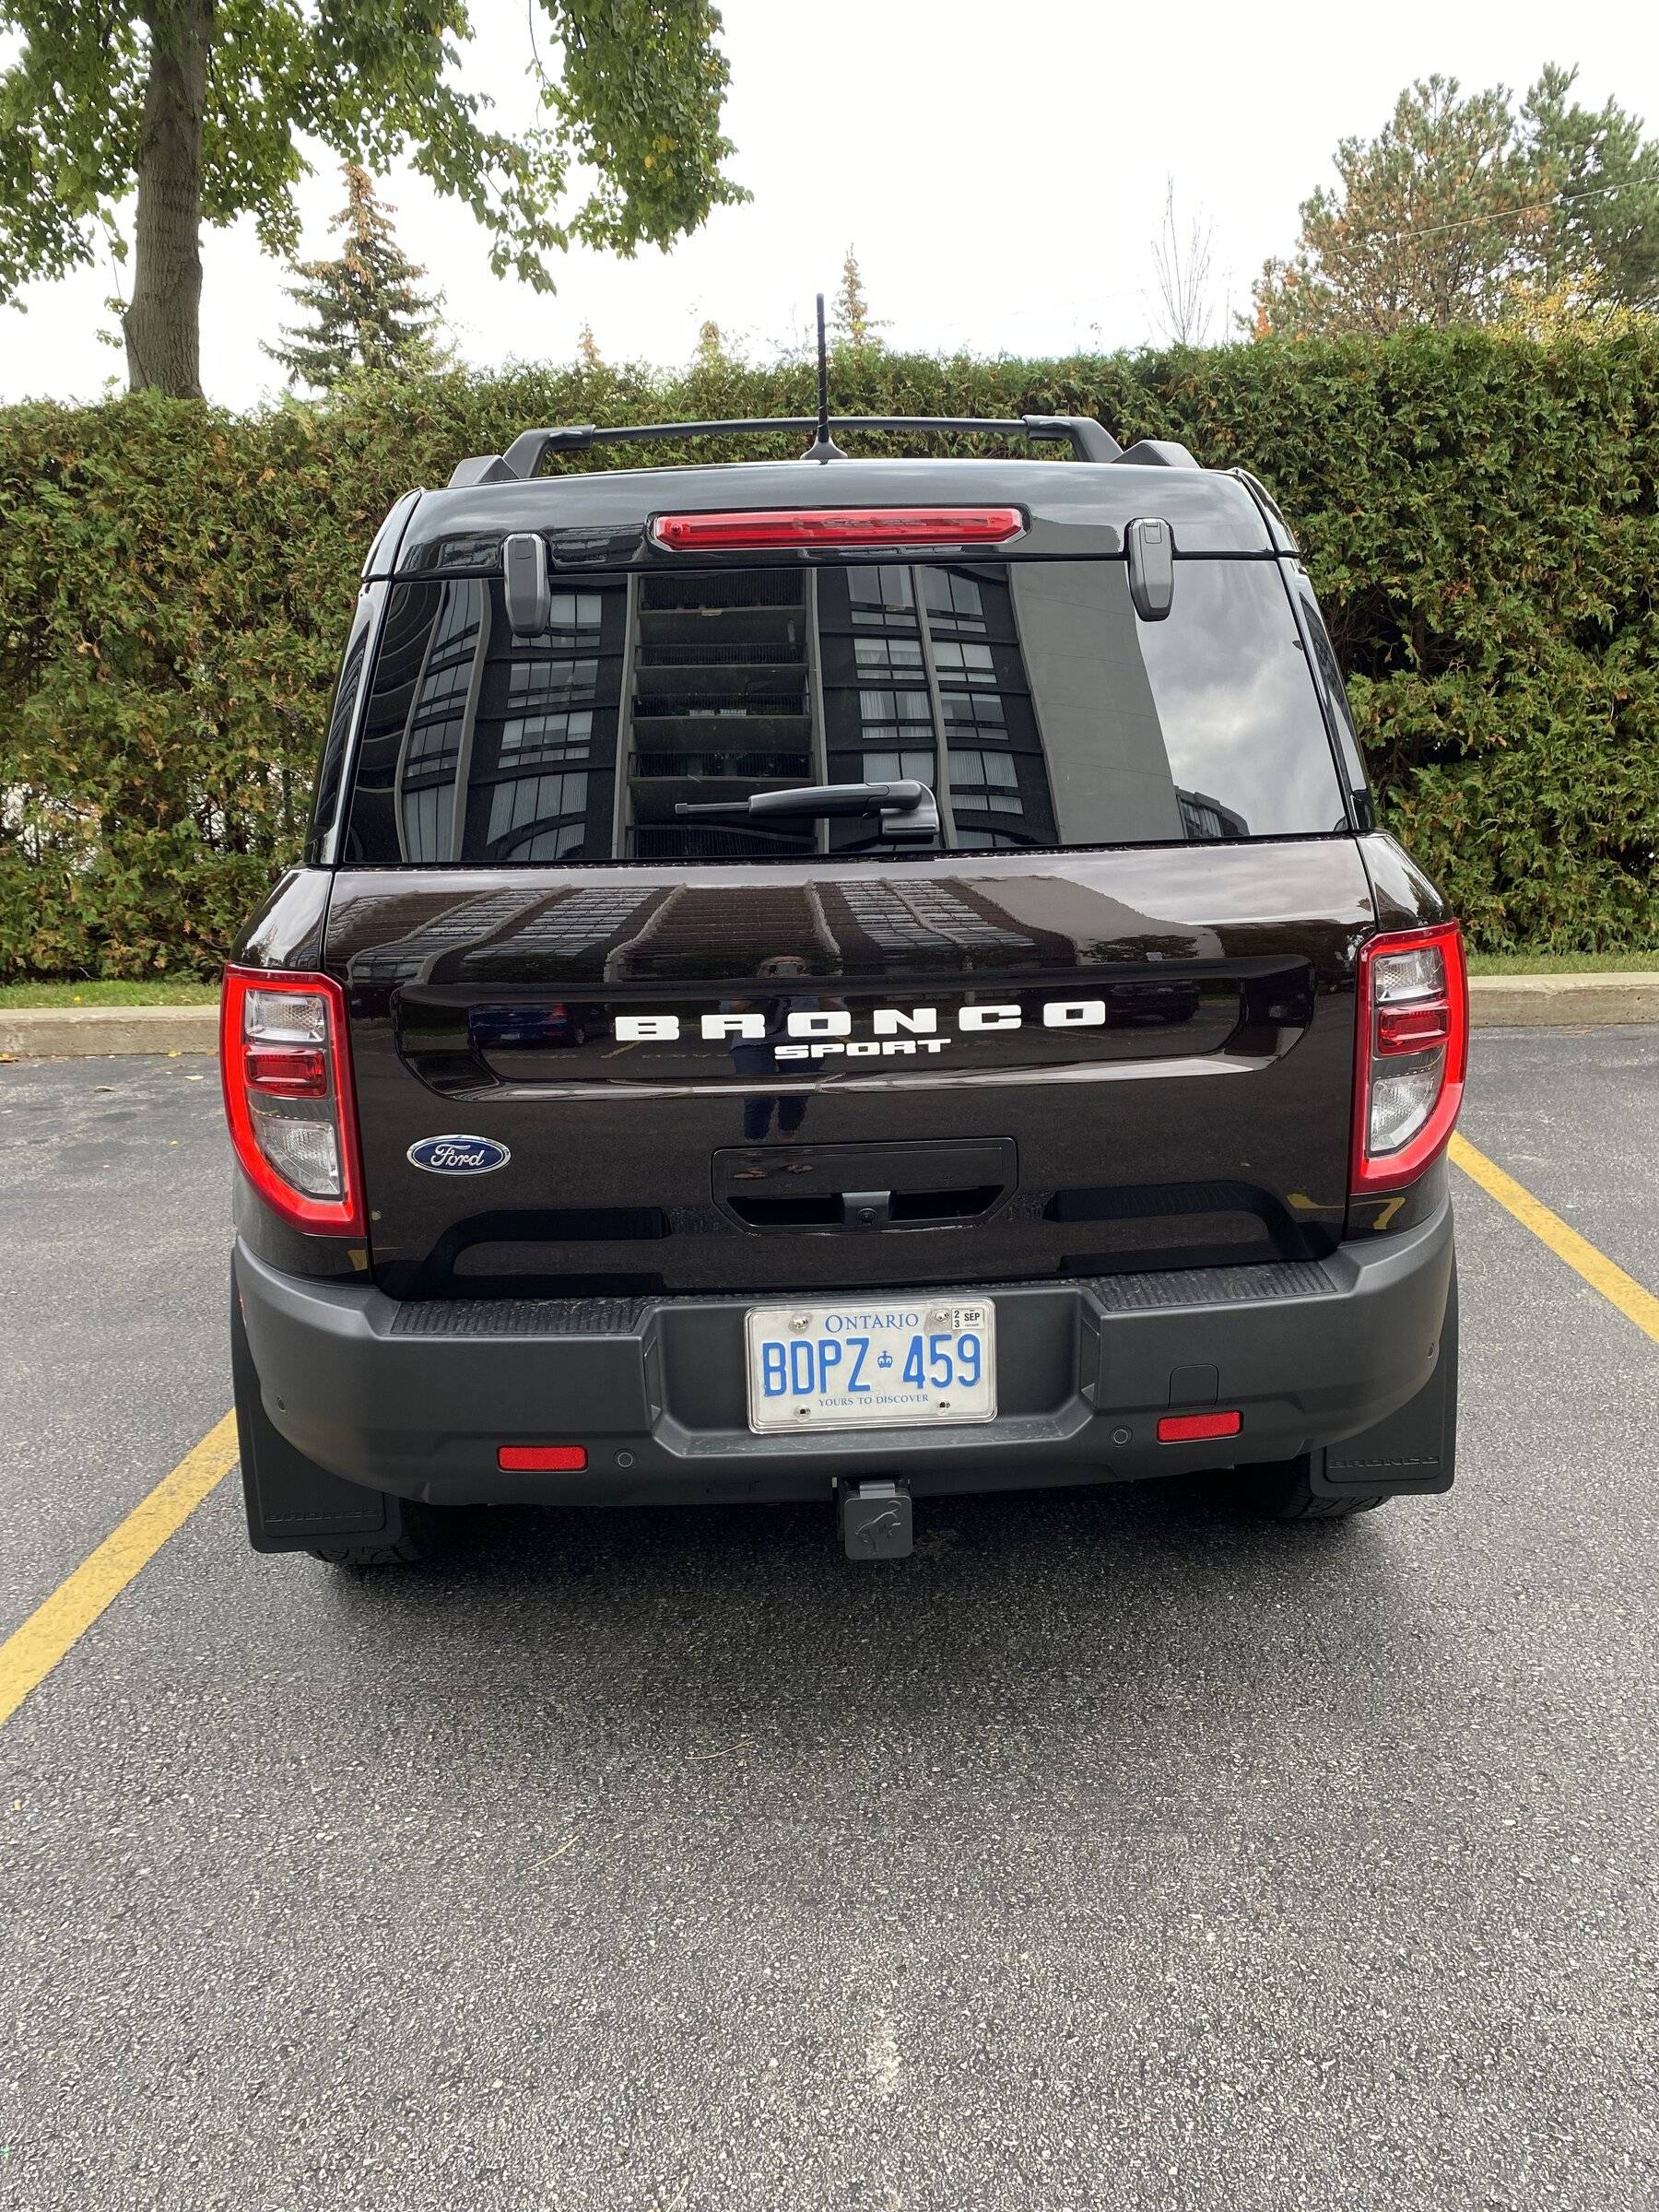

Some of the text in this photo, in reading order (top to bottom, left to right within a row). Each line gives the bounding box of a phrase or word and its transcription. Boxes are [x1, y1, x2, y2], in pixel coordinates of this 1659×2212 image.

[615, 1000, 1106, 1041] BRONCO
[774, 1038, 952, 1060] SPORT
[430, 1144, 485, 1167] Ford
[963, 1312, 981, 1322] SEP
[761, 1333, 982, 1397] BDPZ 459
[818, 1393, 929, 1407] YOURS TO DISCOVER
